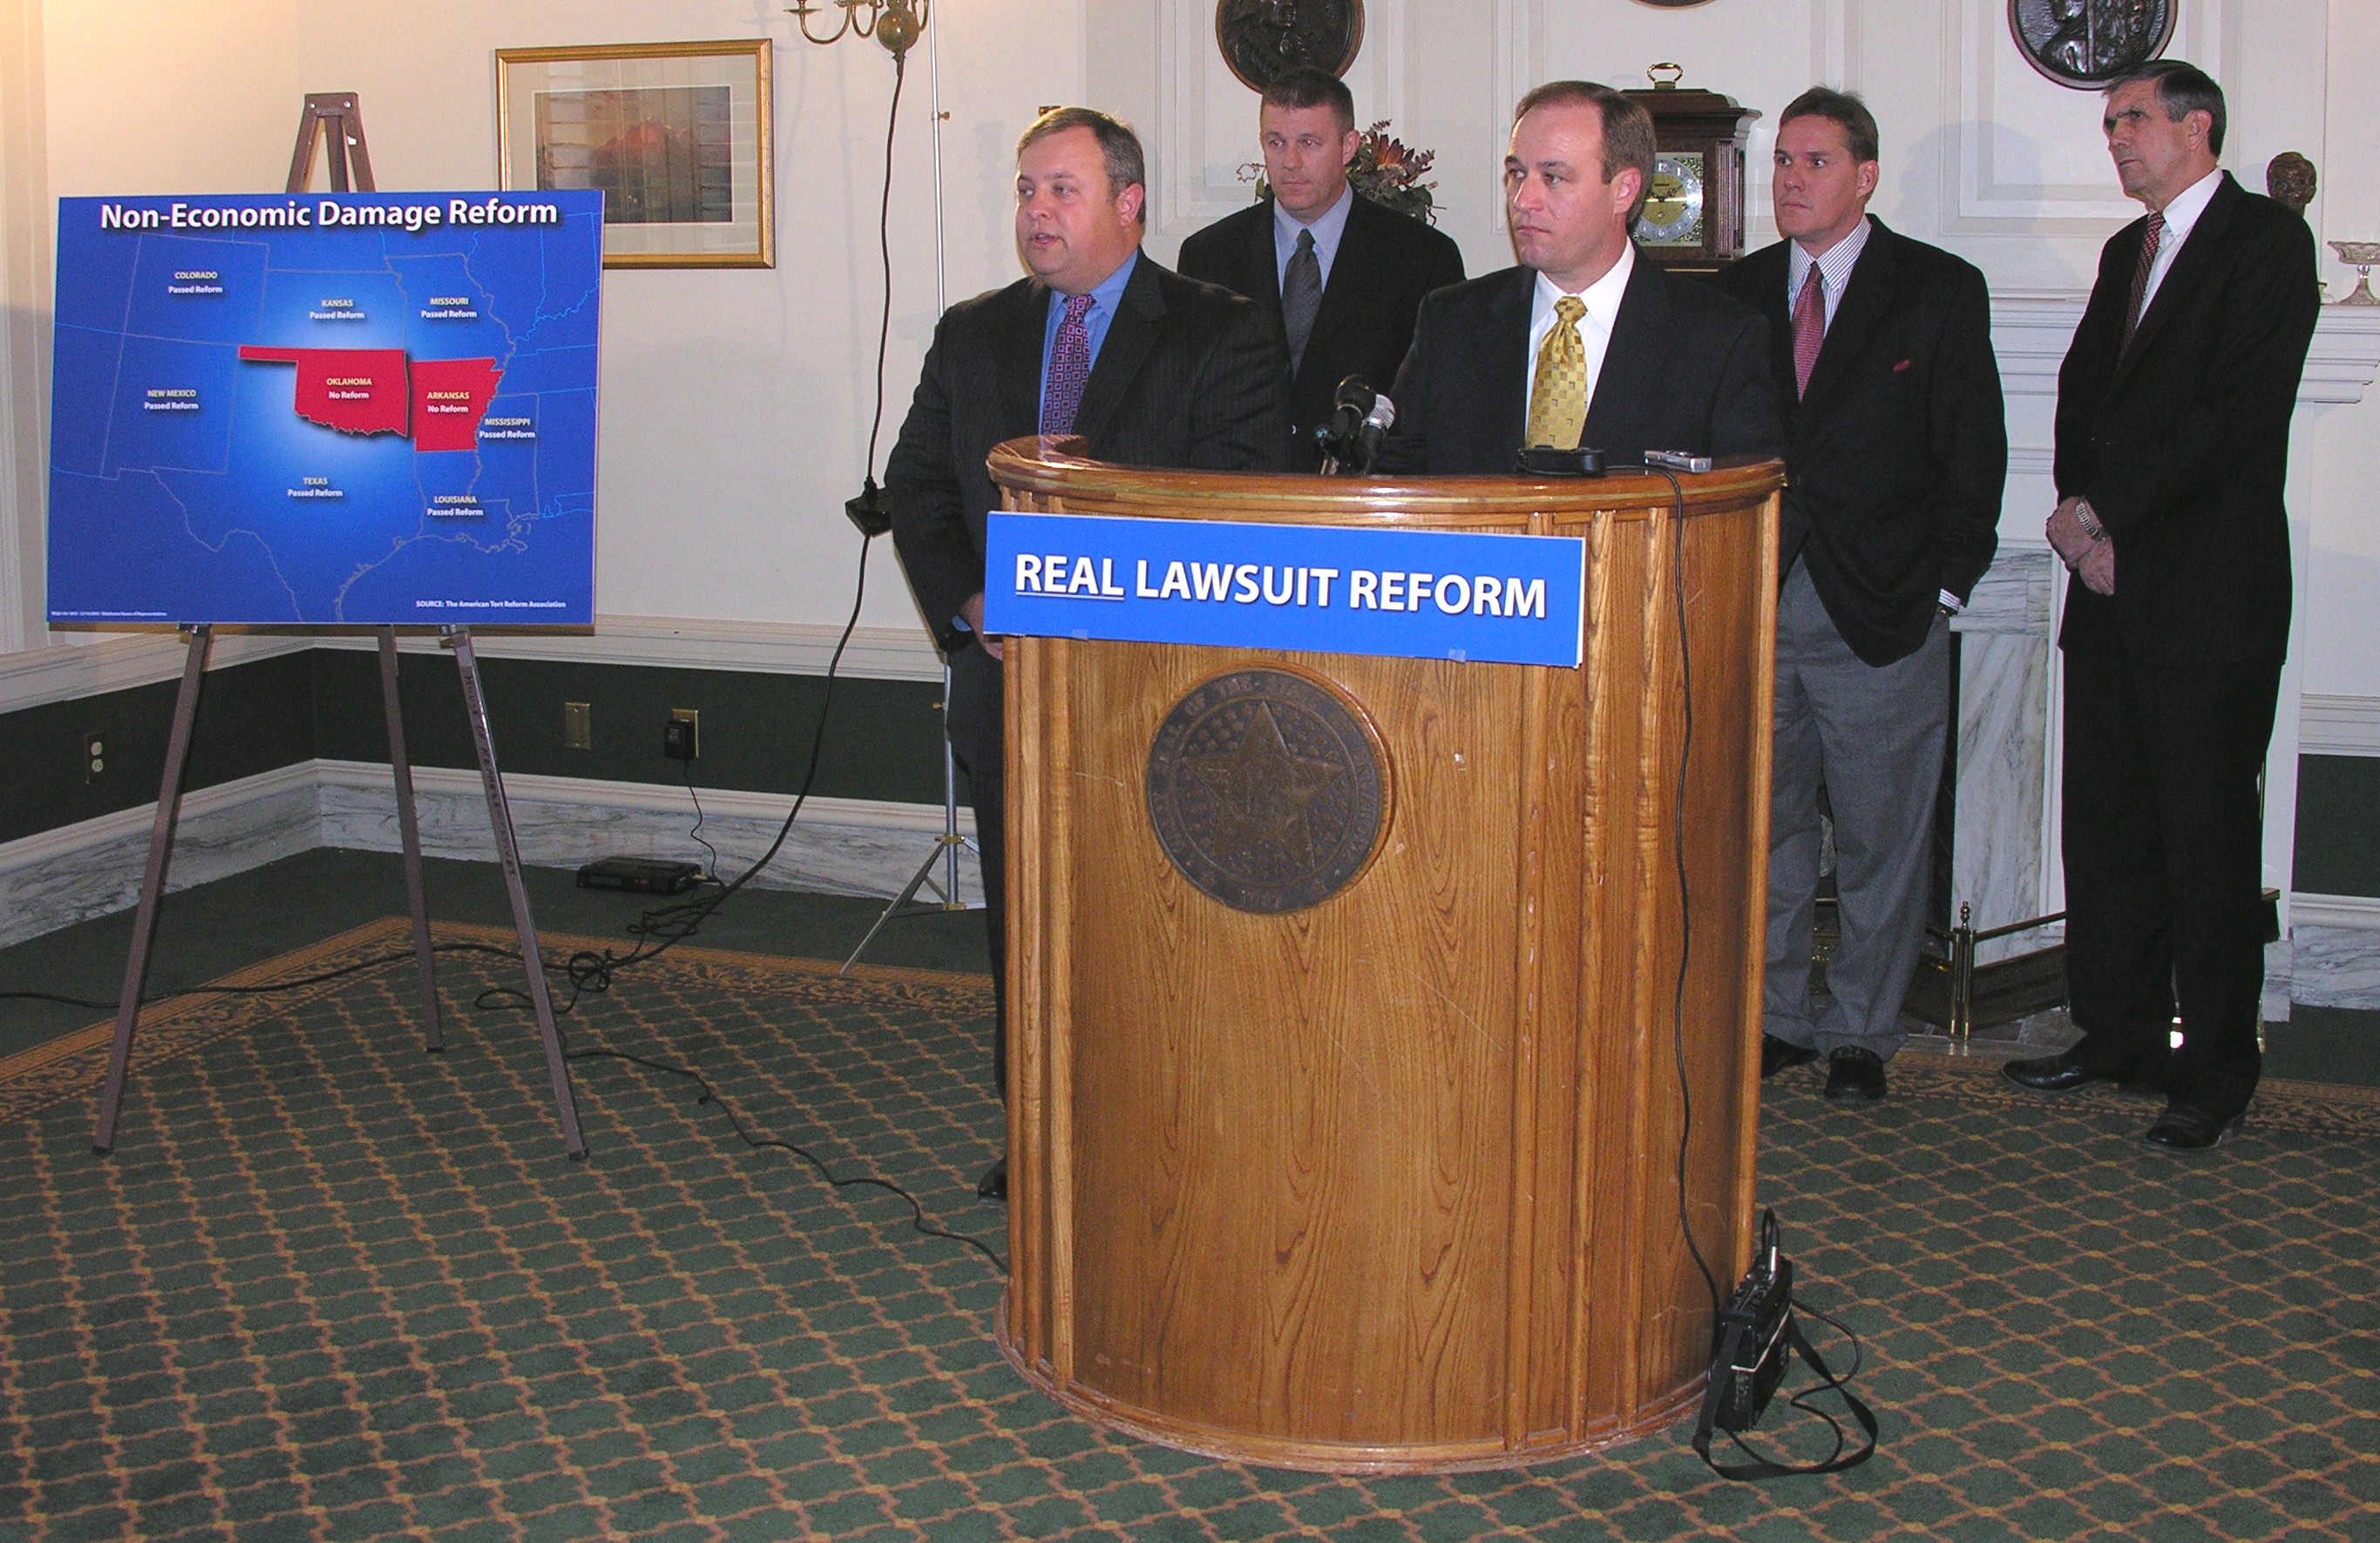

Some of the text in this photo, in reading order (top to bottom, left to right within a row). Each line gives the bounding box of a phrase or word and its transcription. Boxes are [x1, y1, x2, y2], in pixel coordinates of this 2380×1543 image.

[1686, 179, 1693, 189] 2
[100, 198, 557, 232] Non-Economic Damage Reform
[174, 271, 218, 280] COLORADO
[168, 286, 223, 294] Passed Reform
[321, 299, 354, 308] KANSAS
[430, 297, 469, 306] MISSOURI
[309, 311, 364, 320] Passed Reform
[421, 310, 478, 319] Passed Reform
[326, 378, 372, 387] OKLAHOMA
[147, 389, 196, 397] NEW MEXICO
[329, 391, 370, 400] No Reform
[427, 392, 470, 401] ARKANSAS
[145, 402, 199, 410] Passed Reform
[427, 405, 469, 414] No Reform
[485, 418, 531, 427] MISSISSIPPI
[479, 430, 535, 439] Passed Reform
[303, 477, 328, 486] TEXAS
[288, 489, 343, 497] Passed Reform
[434, 496, 477, 504] LOUISIANA
[427, 508, 484, 517] Passed Reform
[1015, 553, 1547, 619] REAL LAWSUIT REFORM
